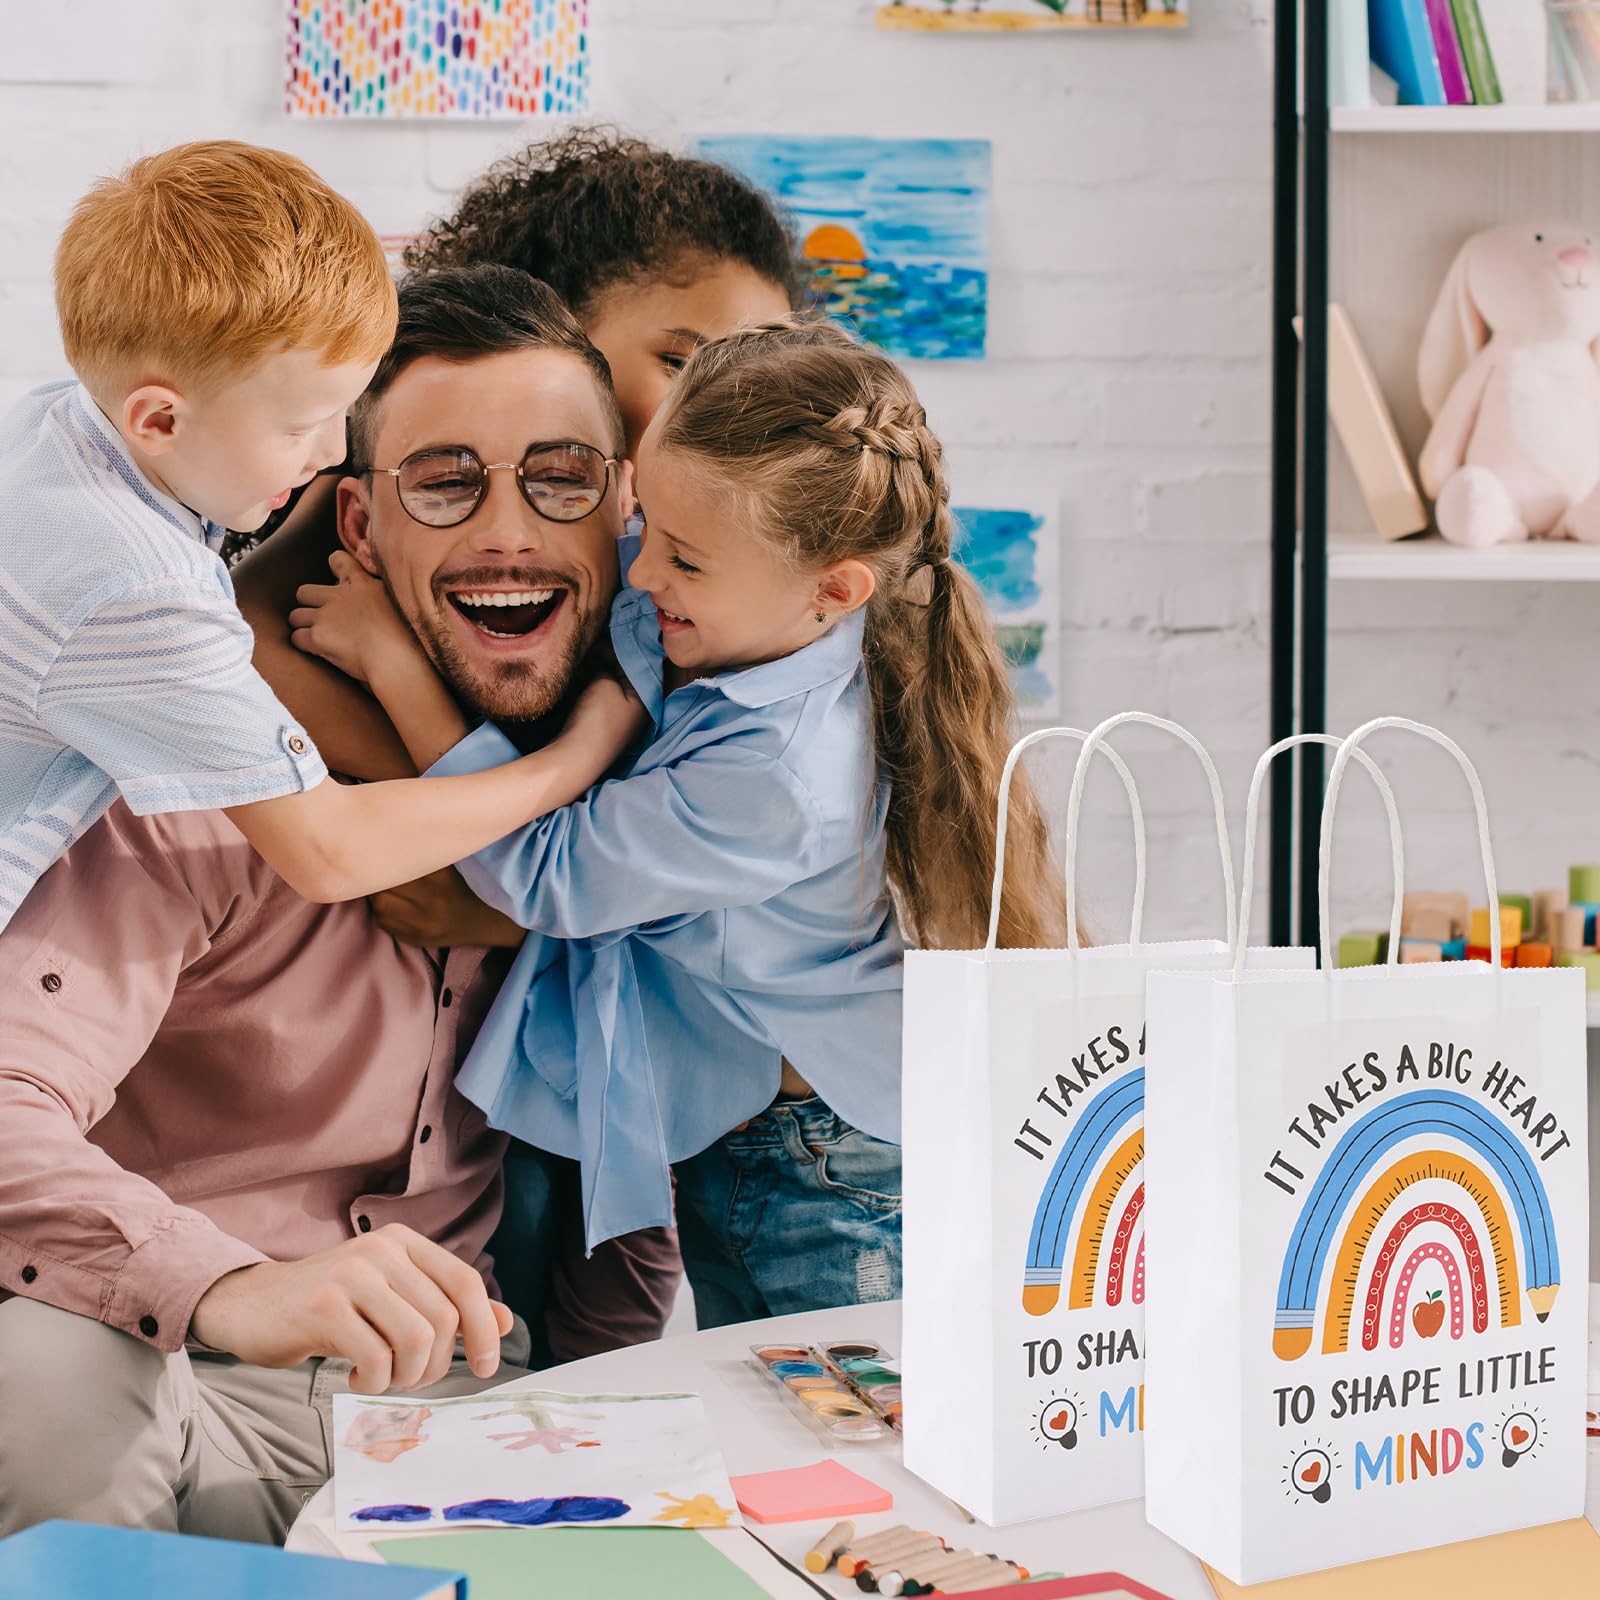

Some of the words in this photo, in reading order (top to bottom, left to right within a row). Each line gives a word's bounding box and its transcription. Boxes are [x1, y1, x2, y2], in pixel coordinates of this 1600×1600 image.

[1013, 1118, 1052, 1161] IT
[1036, 1026, 1130, 1118] TAKES
[1263, 1150, 1305, 1196] IT
[1288, 1051, 1387, 1149] TAKES
[1396, 1044, 1420, 1084] A
[1427, 1042, 1473, 1085] BIG
[1481, 1060, 1571, 1162] HEART
[1022, 1338, 1063, 1378] TO
[1076, 1328, 1145, 1371] SHA
[1272, 1384, 1315, 1427] TO
[1330, 1367, 1442, 1419] SHAPE
[1459, 1346, 1556, 1399] LITTLE
[1355, 1422, 1484, 1490] MINDS
